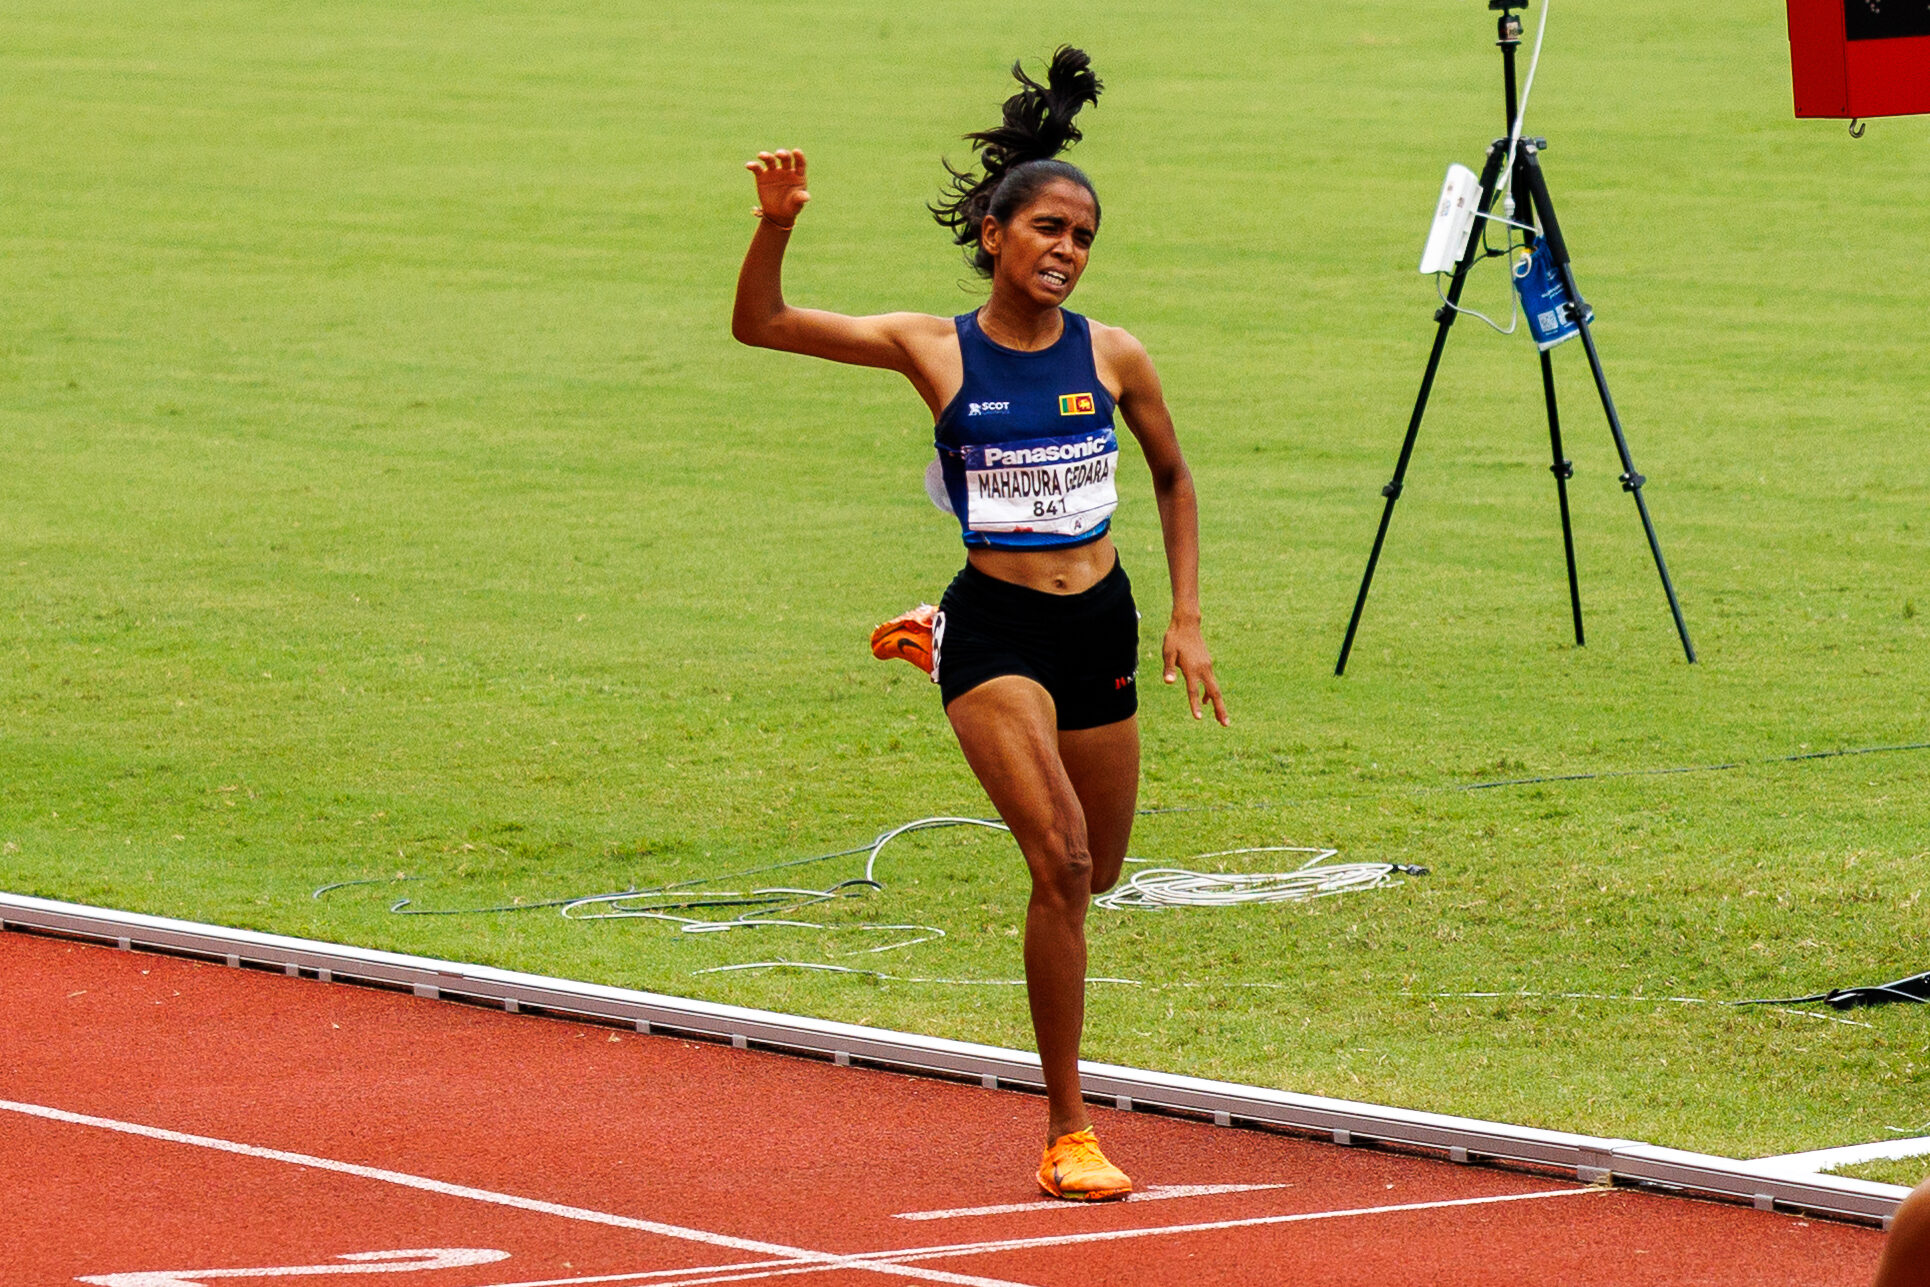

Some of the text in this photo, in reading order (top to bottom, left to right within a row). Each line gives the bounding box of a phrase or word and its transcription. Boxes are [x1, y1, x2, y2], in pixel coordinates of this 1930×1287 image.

[982, 401, 1010, 411] SCOT
[984, 436, 1107, 467] Panasonic
[978, 457, 1109, 499] MAHADURA GEDARA
[1033, 499, 1067, 517] 841
